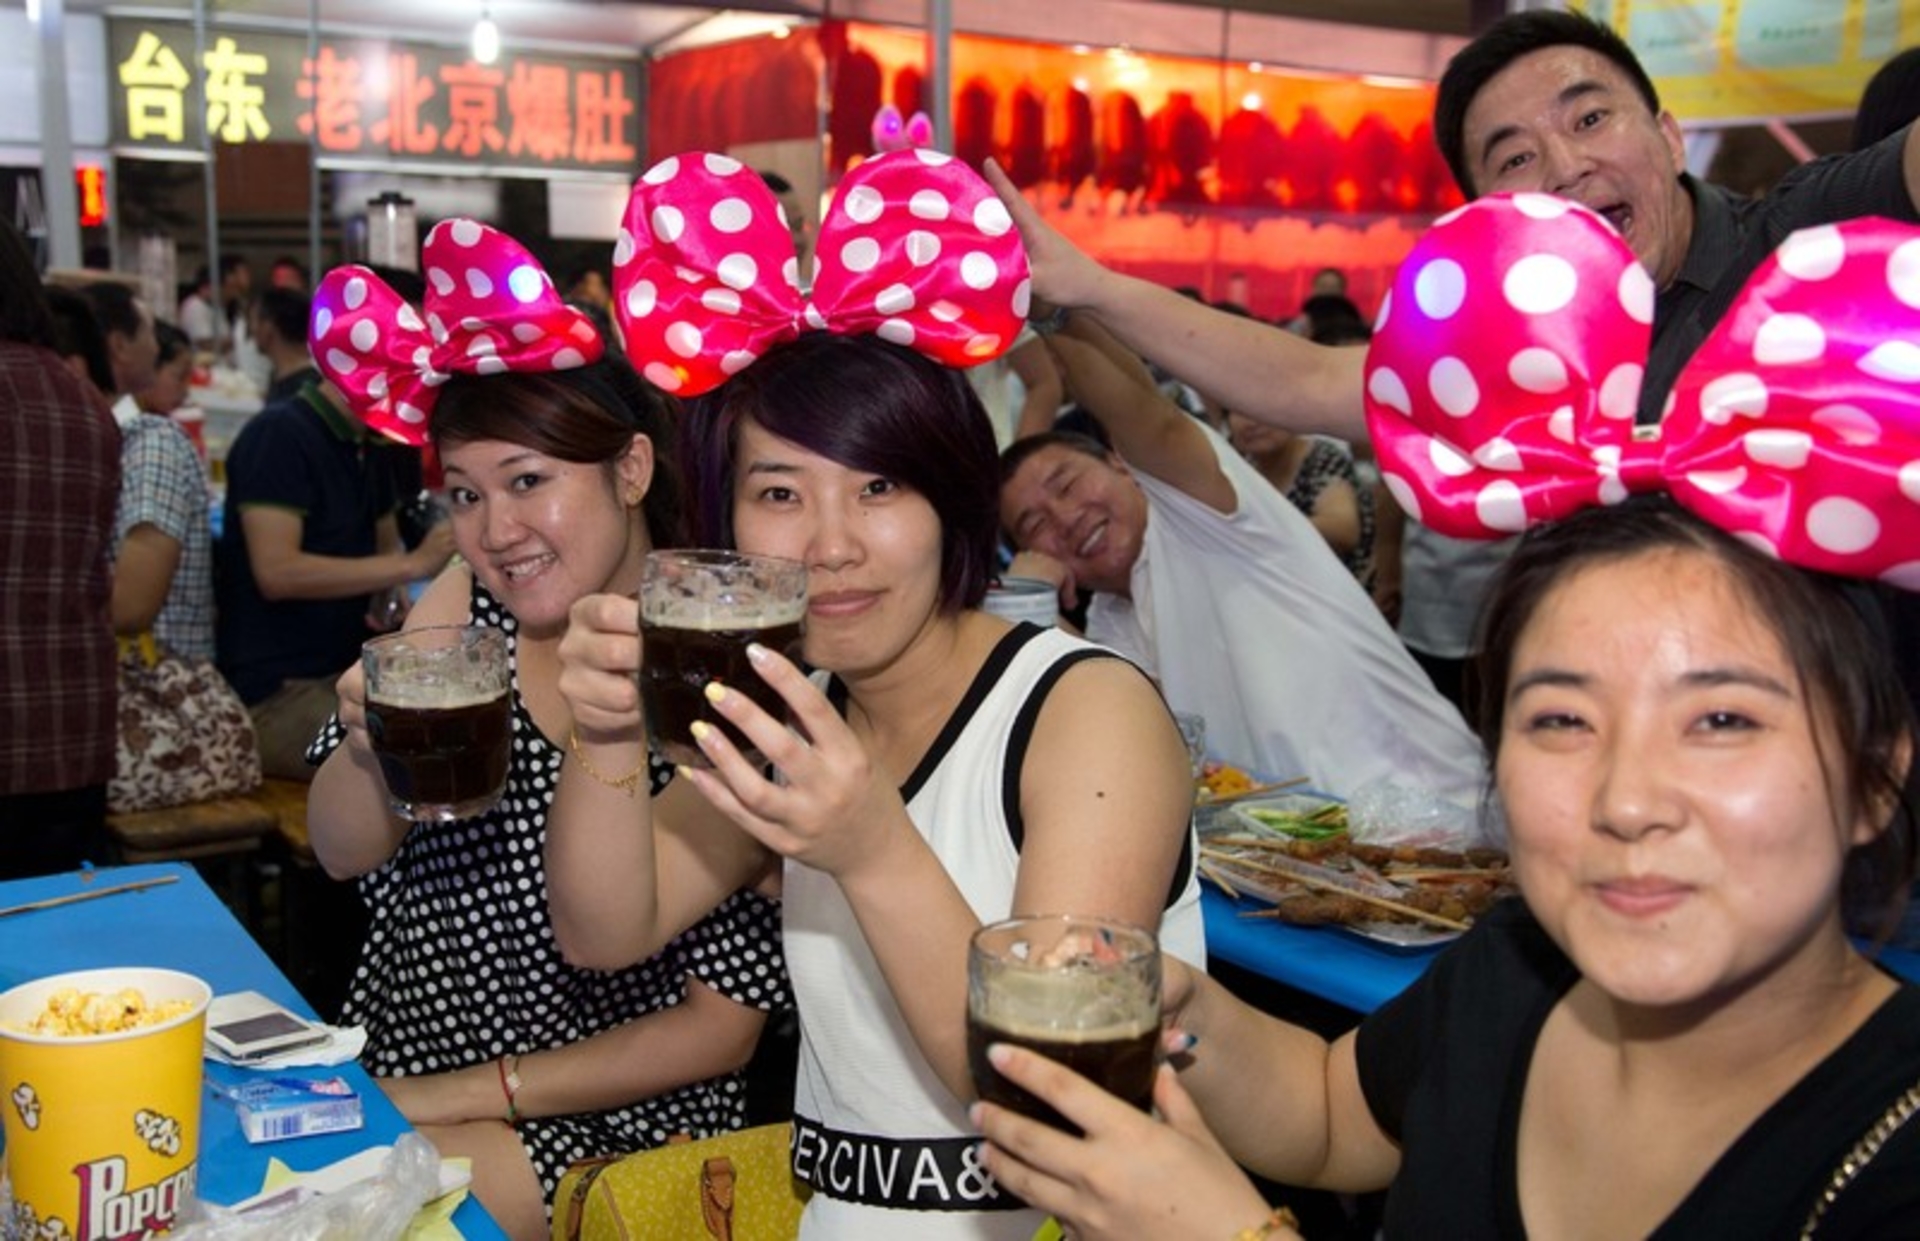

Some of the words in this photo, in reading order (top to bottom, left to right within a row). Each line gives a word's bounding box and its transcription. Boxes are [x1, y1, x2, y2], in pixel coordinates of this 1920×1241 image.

[119, 31, 271, 143] 台东
[295, 46, 636, 162] 老北京爆肚
